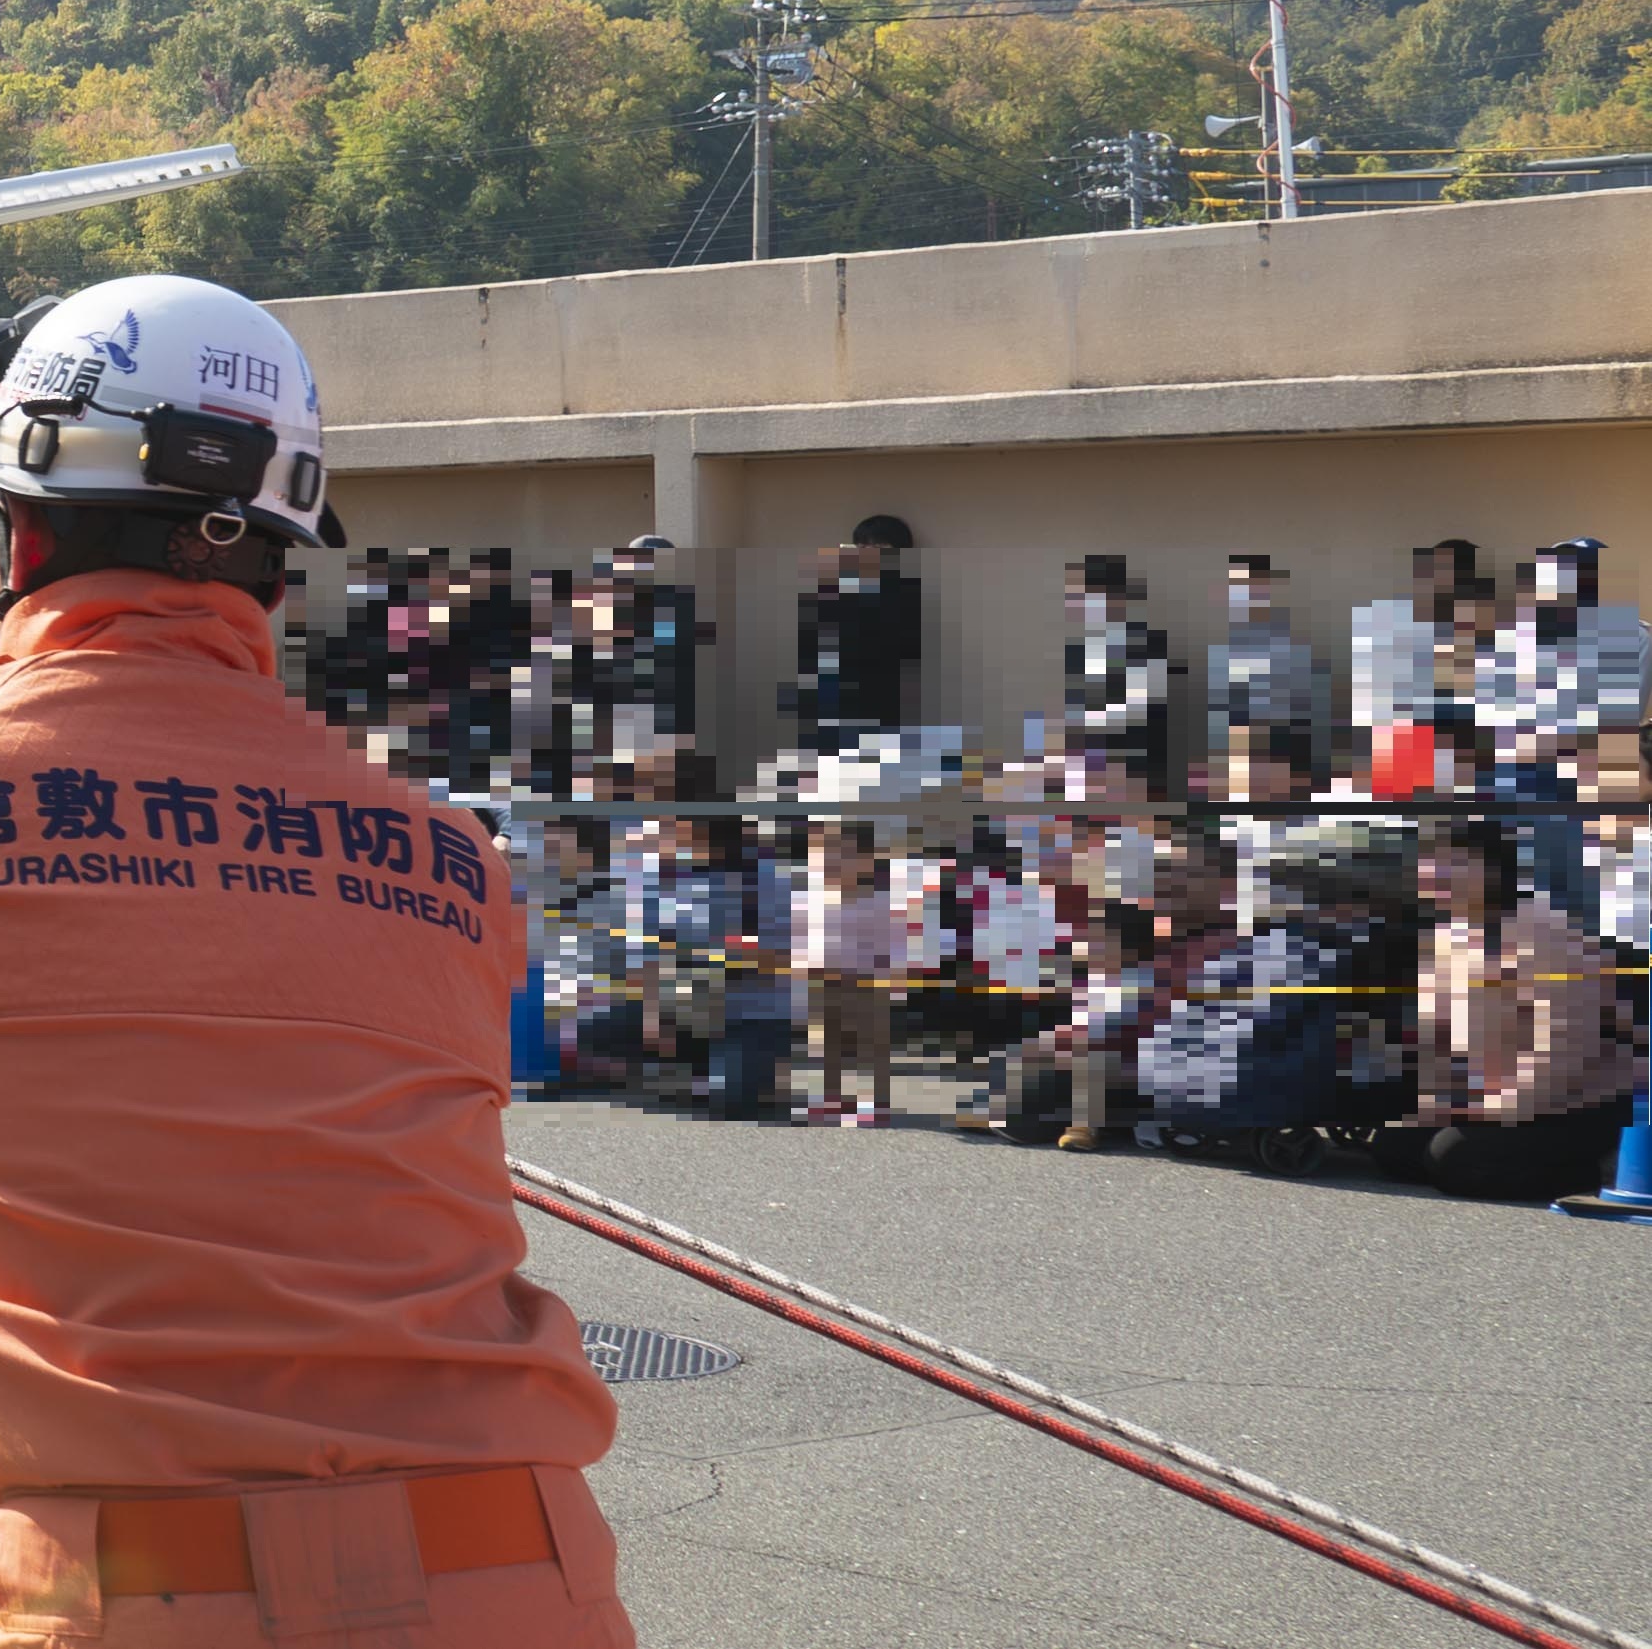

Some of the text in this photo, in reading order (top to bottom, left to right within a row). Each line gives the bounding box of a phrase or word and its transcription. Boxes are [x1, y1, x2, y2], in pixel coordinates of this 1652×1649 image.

[199, 345, 280, 401] 河田
[219, 861, 317, 898] FIRE
[336, 872, 483, 945] BUREAU
